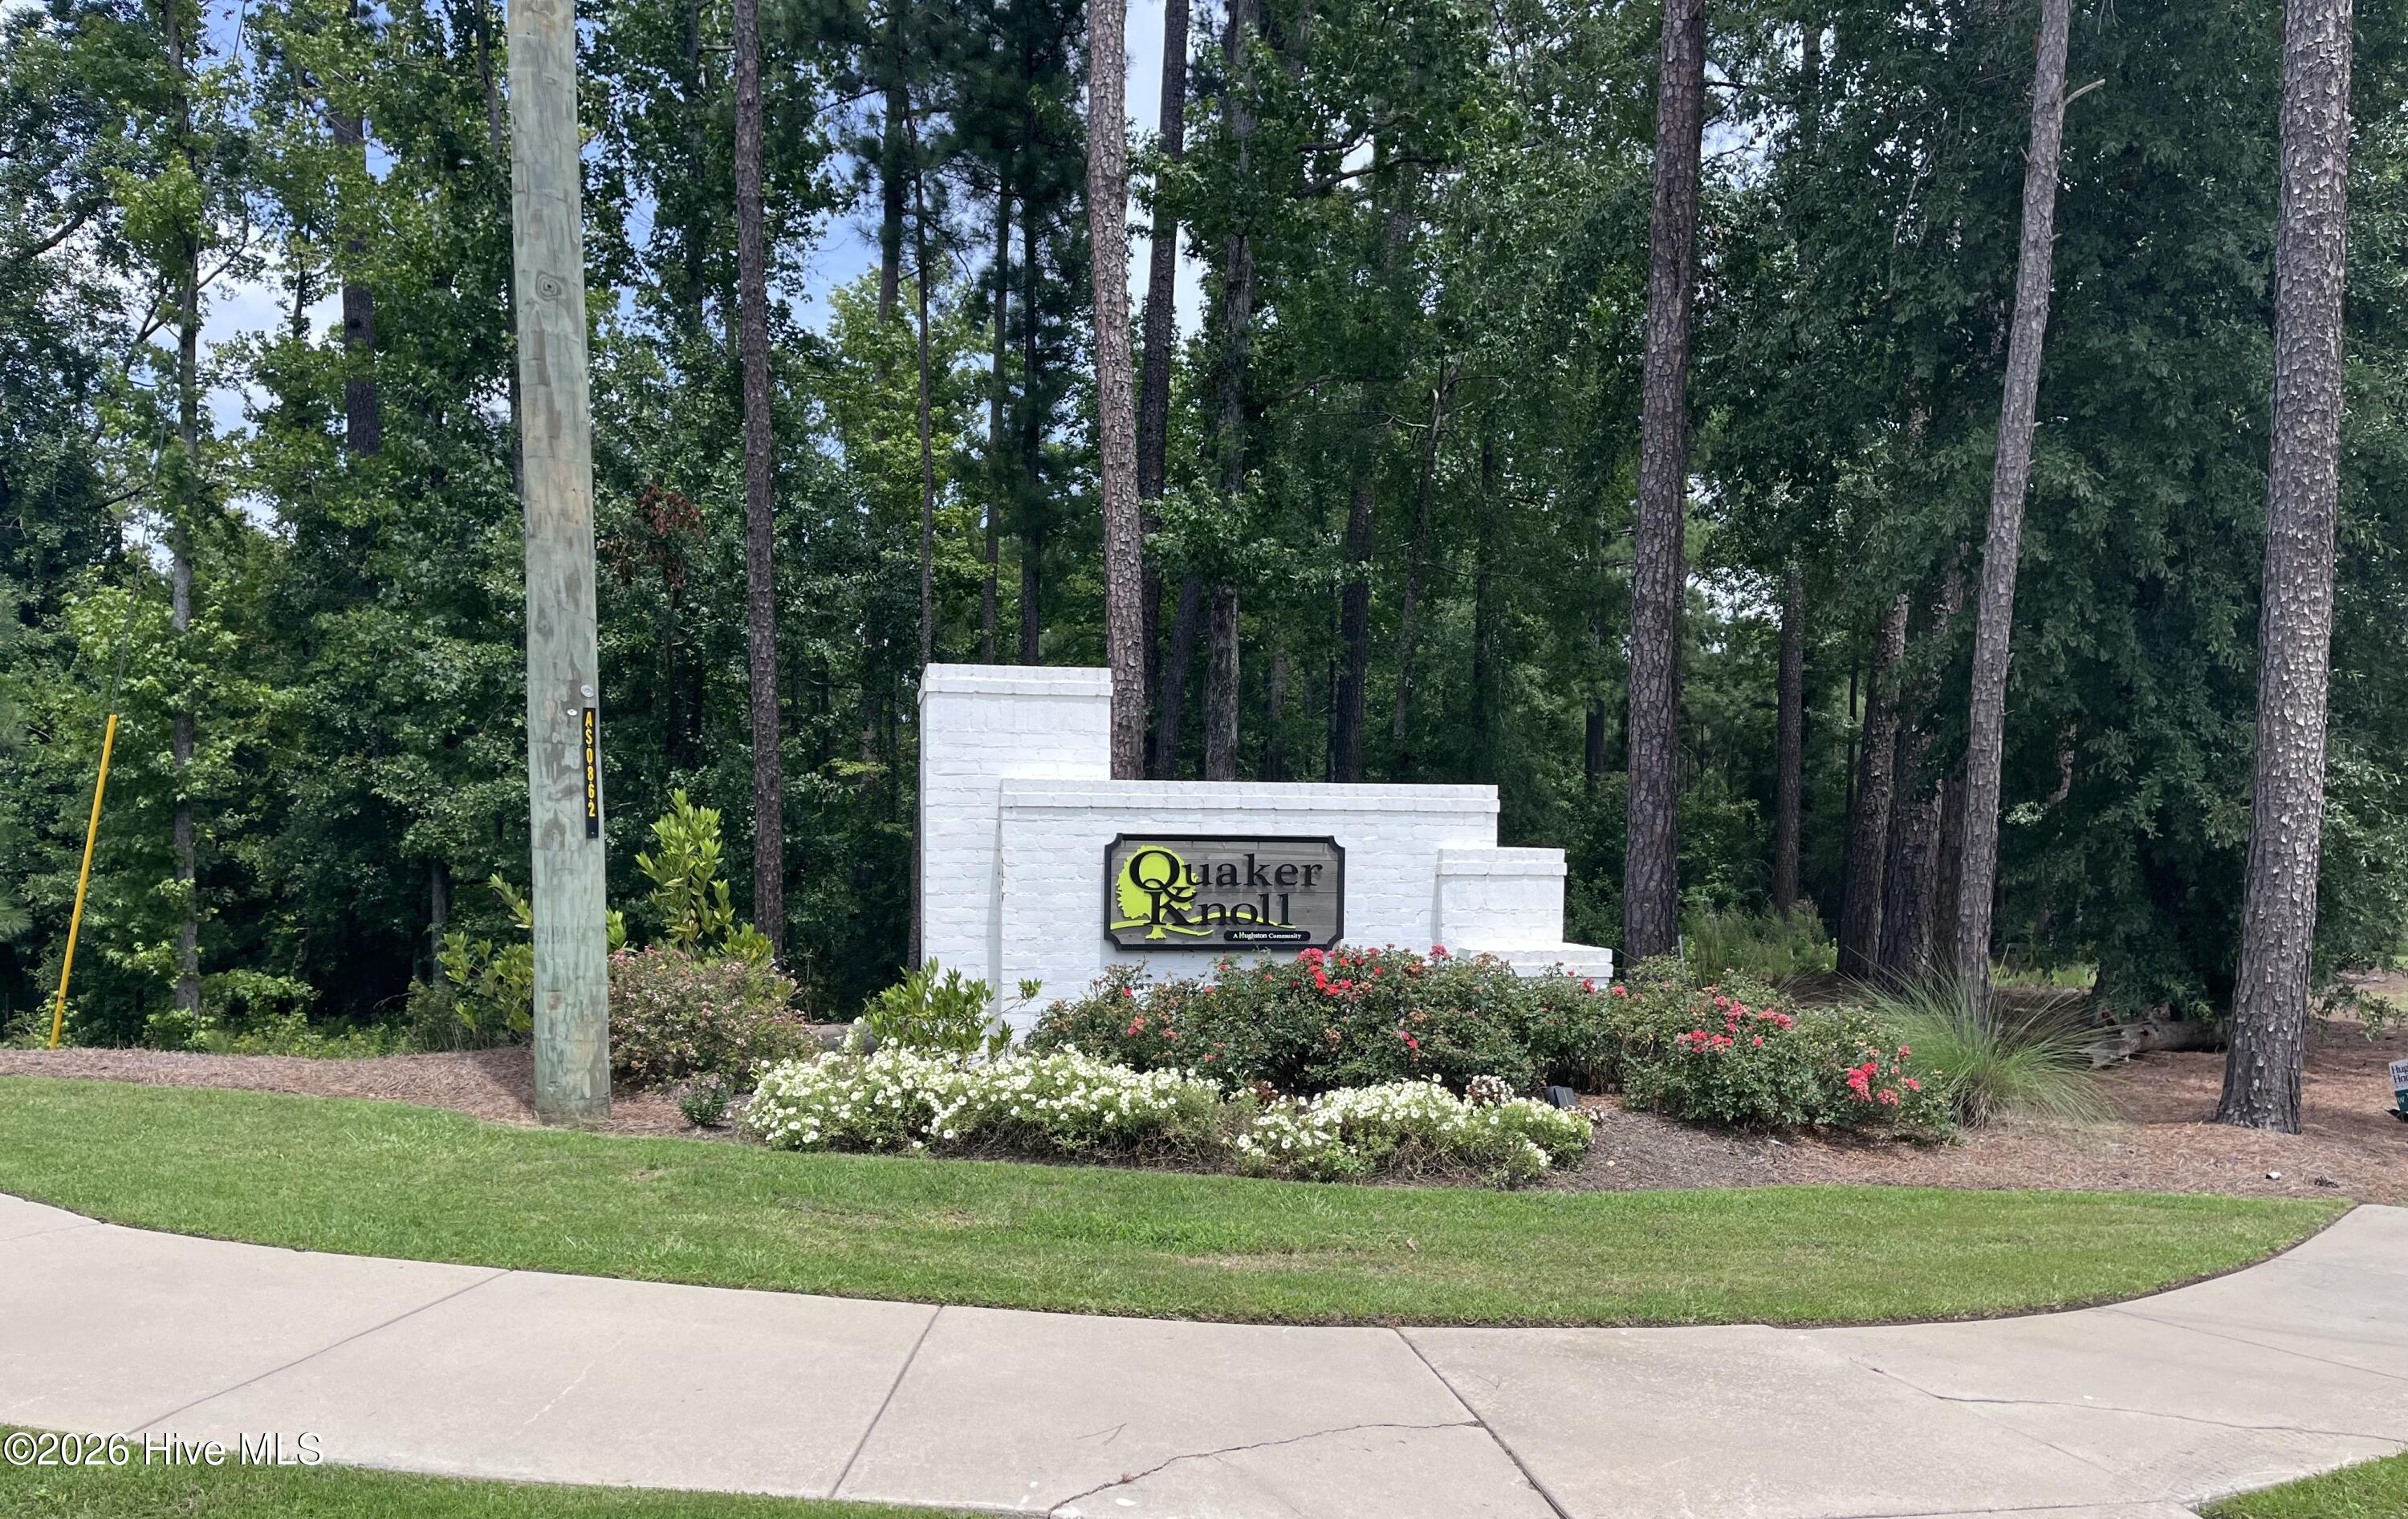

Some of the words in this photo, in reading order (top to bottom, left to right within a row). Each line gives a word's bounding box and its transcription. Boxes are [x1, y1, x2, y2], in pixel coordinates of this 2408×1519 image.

[1129, 850, 1323, 903] Quaker
[1143, 887, 1294, 926] Knoll
[1239, 932, 1267, 940] Hughston
